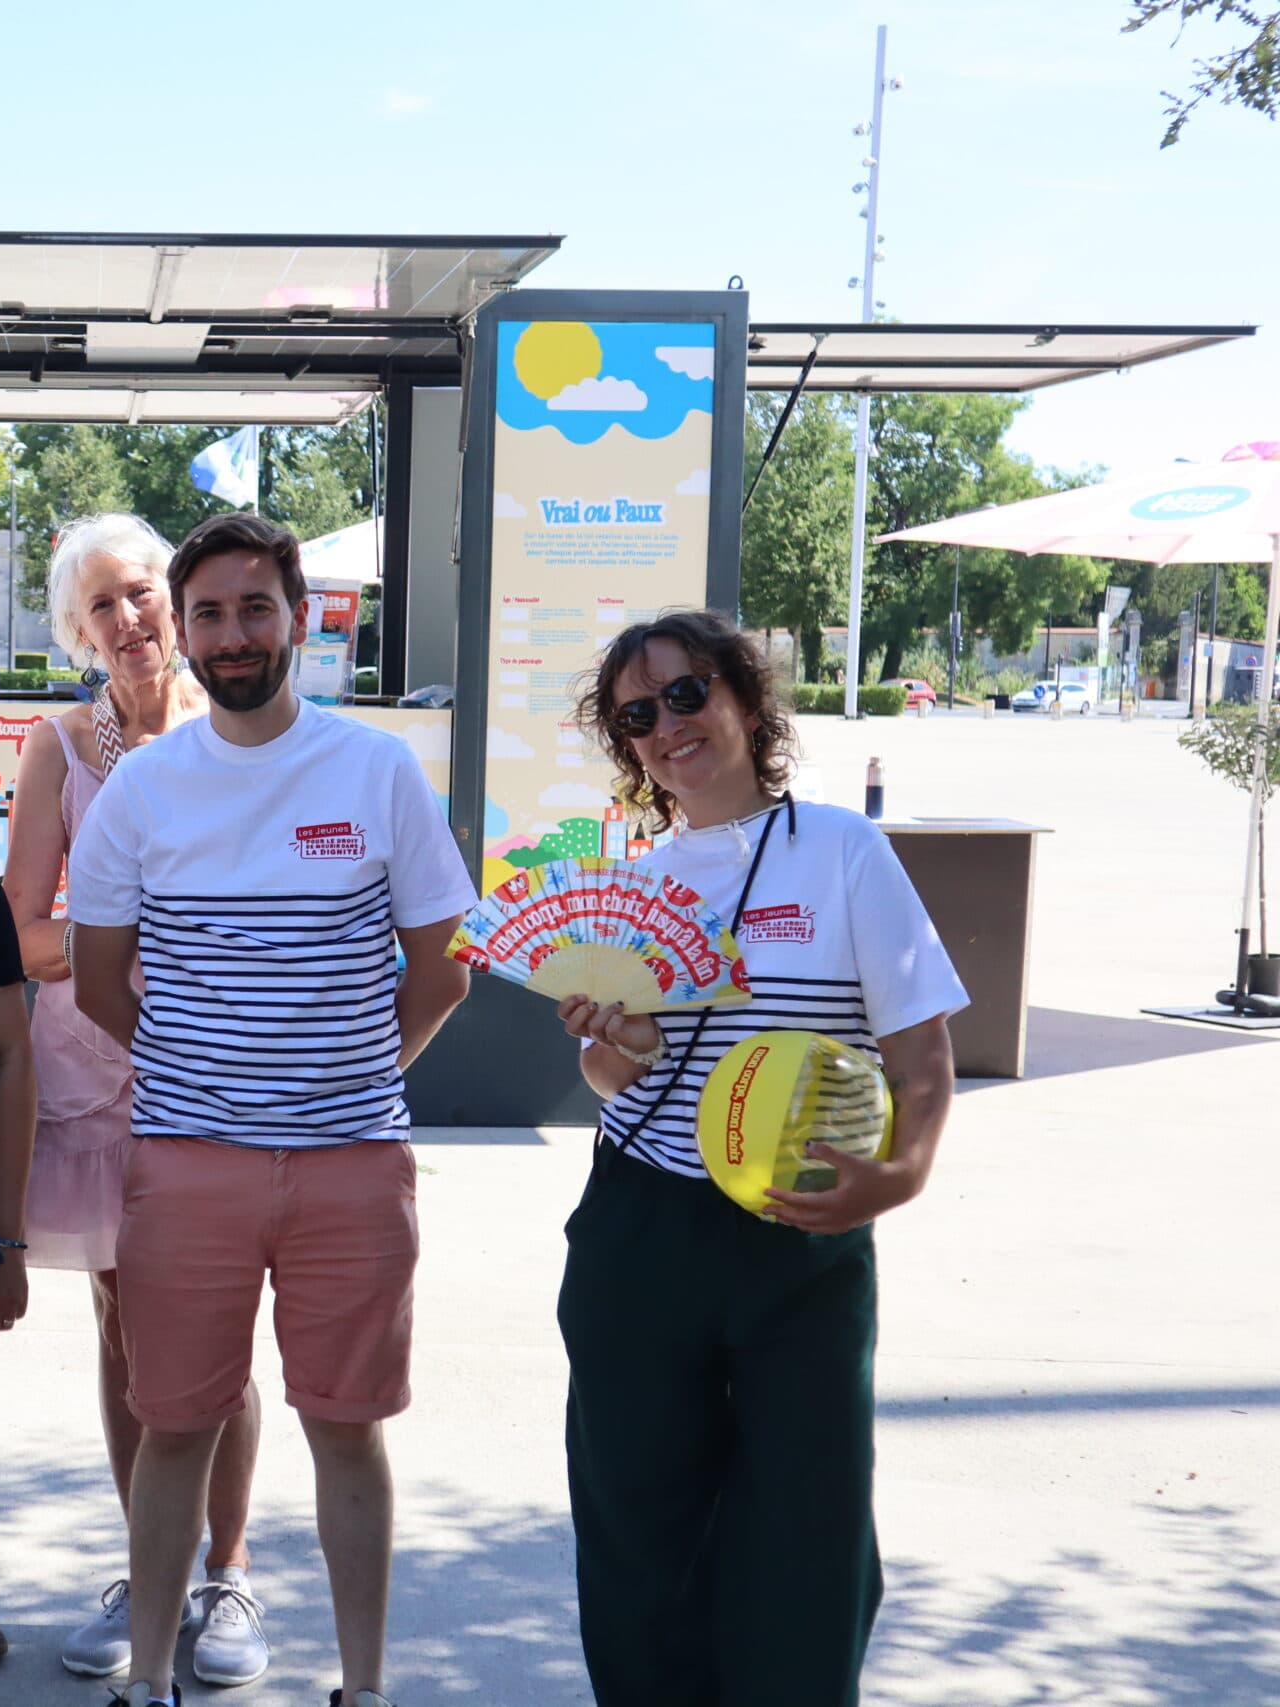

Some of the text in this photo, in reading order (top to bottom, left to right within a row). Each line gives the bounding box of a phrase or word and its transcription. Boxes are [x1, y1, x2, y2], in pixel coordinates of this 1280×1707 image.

[540, 499, 662, 524] Vrai ou Faux
[298, 826, 349, 837] Les Jeunes
[524, 900, 567, 930] corps,
[566, 893, 600, 913] mon
[602, 890, 644, 922] choix,
[745, 913, 760, 921] Les
[493, 923, 528, 957] mon
[684, 940, 704, 962] la
[693, 957, 716, 982] fin
[747, 1048, 764, 1068] mon
[730, 1101, 742, 1128] mon
[729, 1130, 742, 1161] choix
